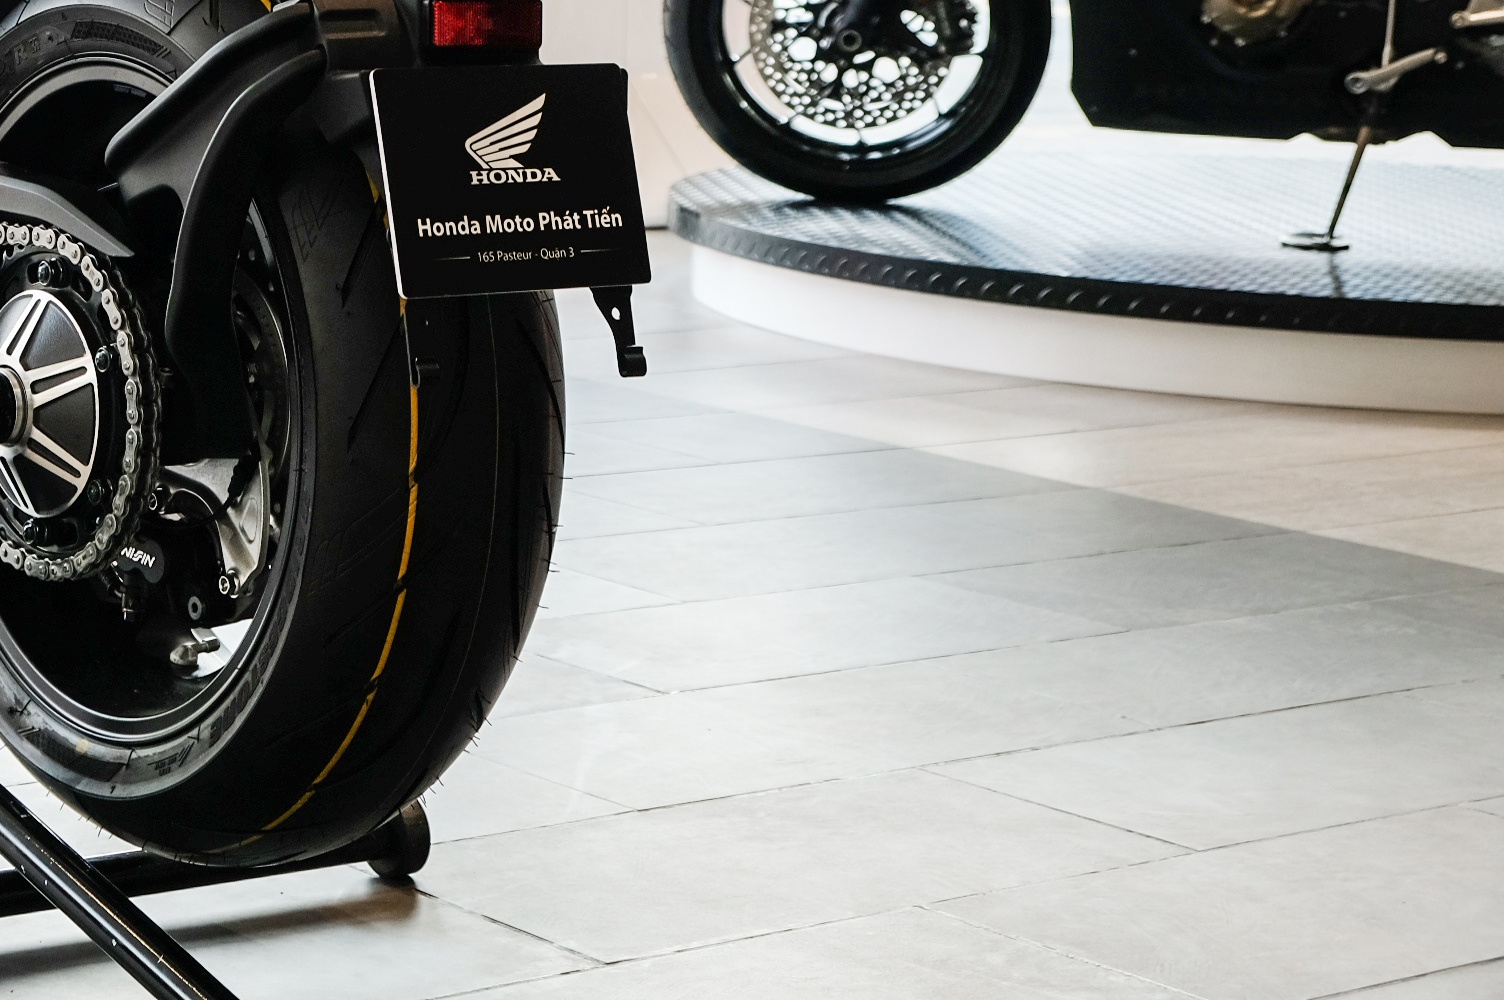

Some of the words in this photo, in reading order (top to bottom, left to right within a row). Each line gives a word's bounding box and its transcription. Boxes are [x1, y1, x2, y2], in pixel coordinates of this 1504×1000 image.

[470, 167, 561, 185] HONDA
[417, 215, 481, 237] Honda
[486, 214, 535, 234] Moto
[538, 210, 582, 231] Phát
[583, 206, 623, 229] Tiến
[478, 251, 494, 263] 165
[497, 249, 532, 262] Pasteur
[540, 247, 567, 261] Quận
[568, 247, 575, 258] 3
